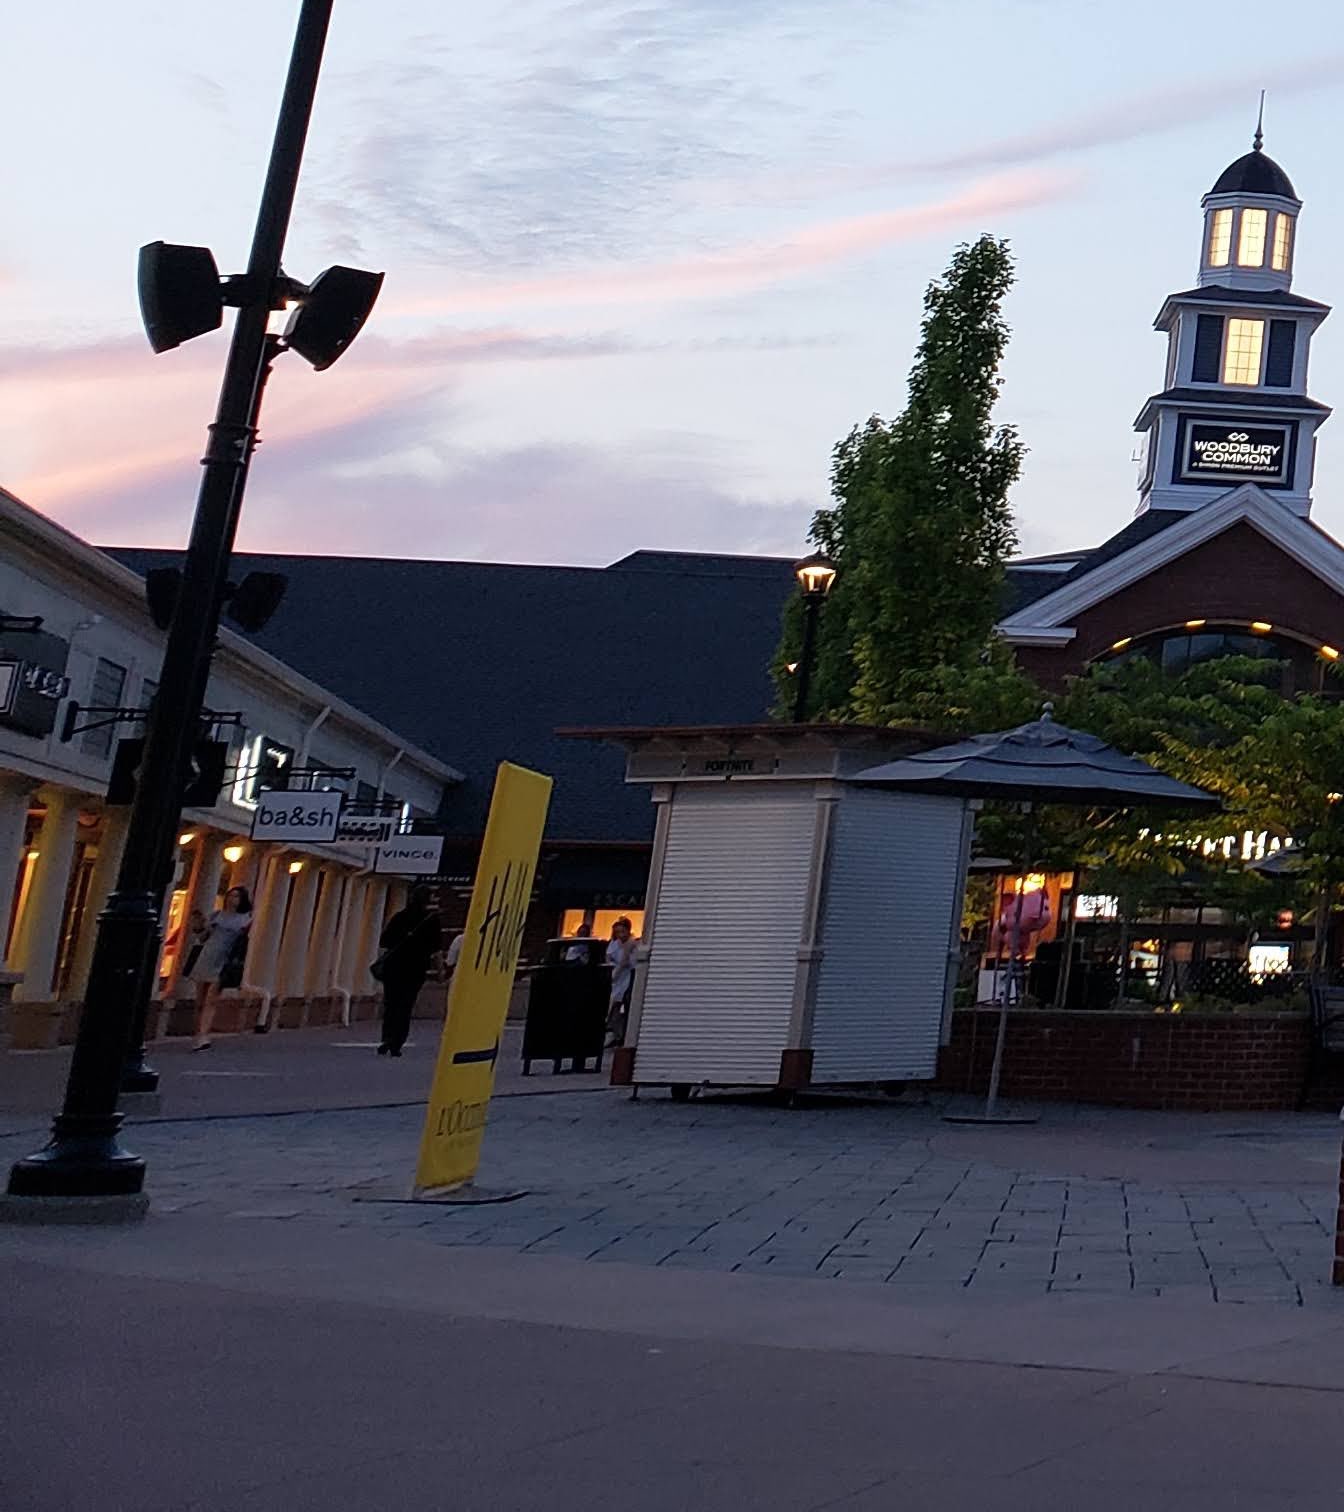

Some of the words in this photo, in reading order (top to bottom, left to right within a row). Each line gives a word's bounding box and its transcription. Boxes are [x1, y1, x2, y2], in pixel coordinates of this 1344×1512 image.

[1194, 440, 1280, 455] WOODBURY
[1202, 451, 1271, 465] COMMON
[259, 806, 334, 828] ba&sh
